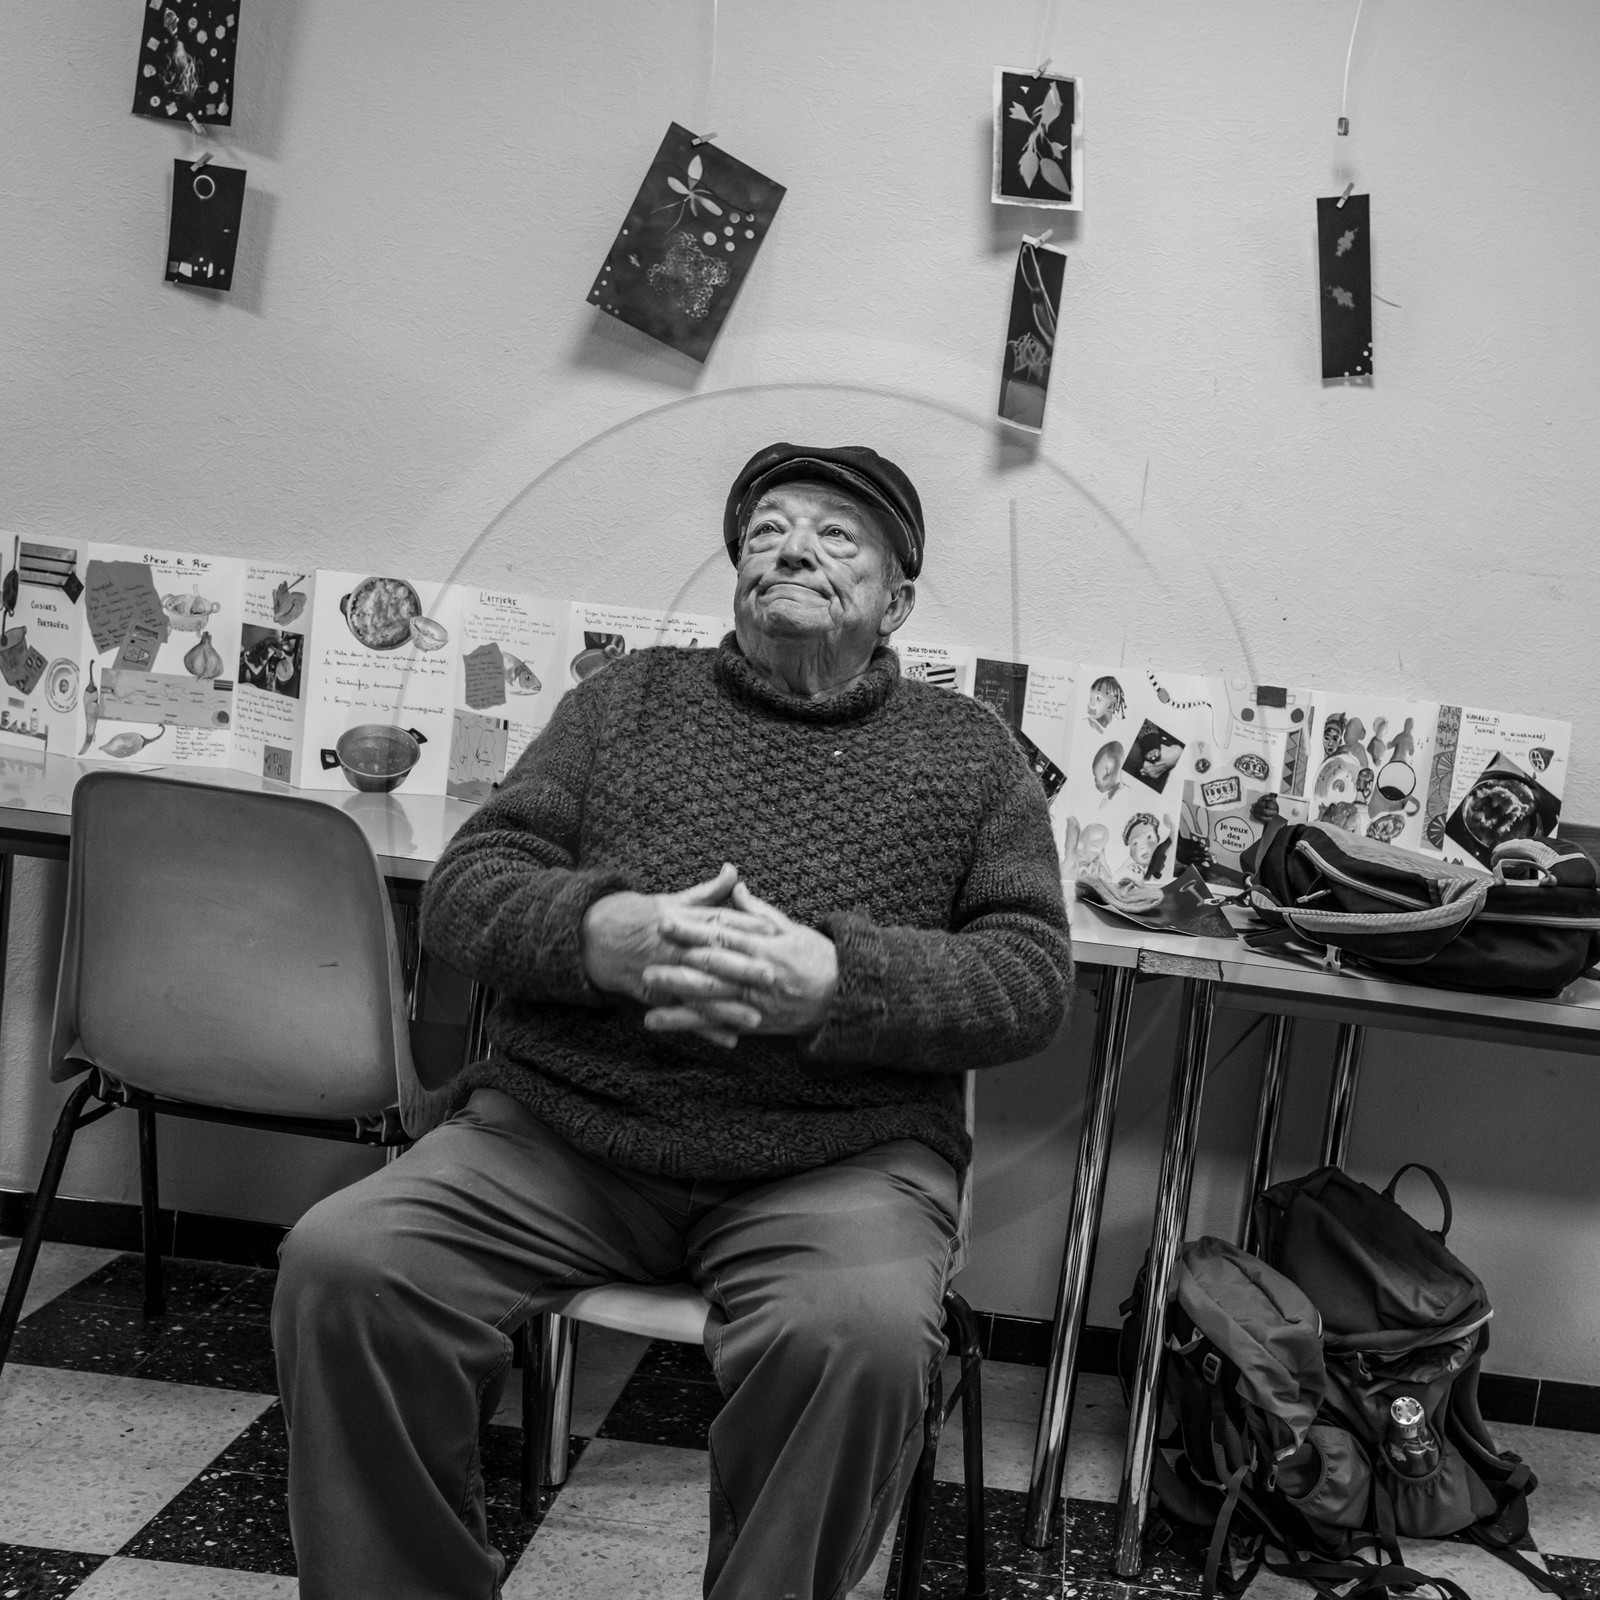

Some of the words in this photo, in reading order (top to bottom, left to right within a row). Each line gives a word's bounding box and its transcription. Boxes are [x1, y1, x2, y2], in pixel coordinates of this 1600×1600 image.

[143, 554, 168, 564] Stew
[907, 646, 948, 656] BRETONNES
[1220, 822, 1228, 831] Je
[1229, 825, 1248, 834] veux
[1227, 832, 1240, 840] des
